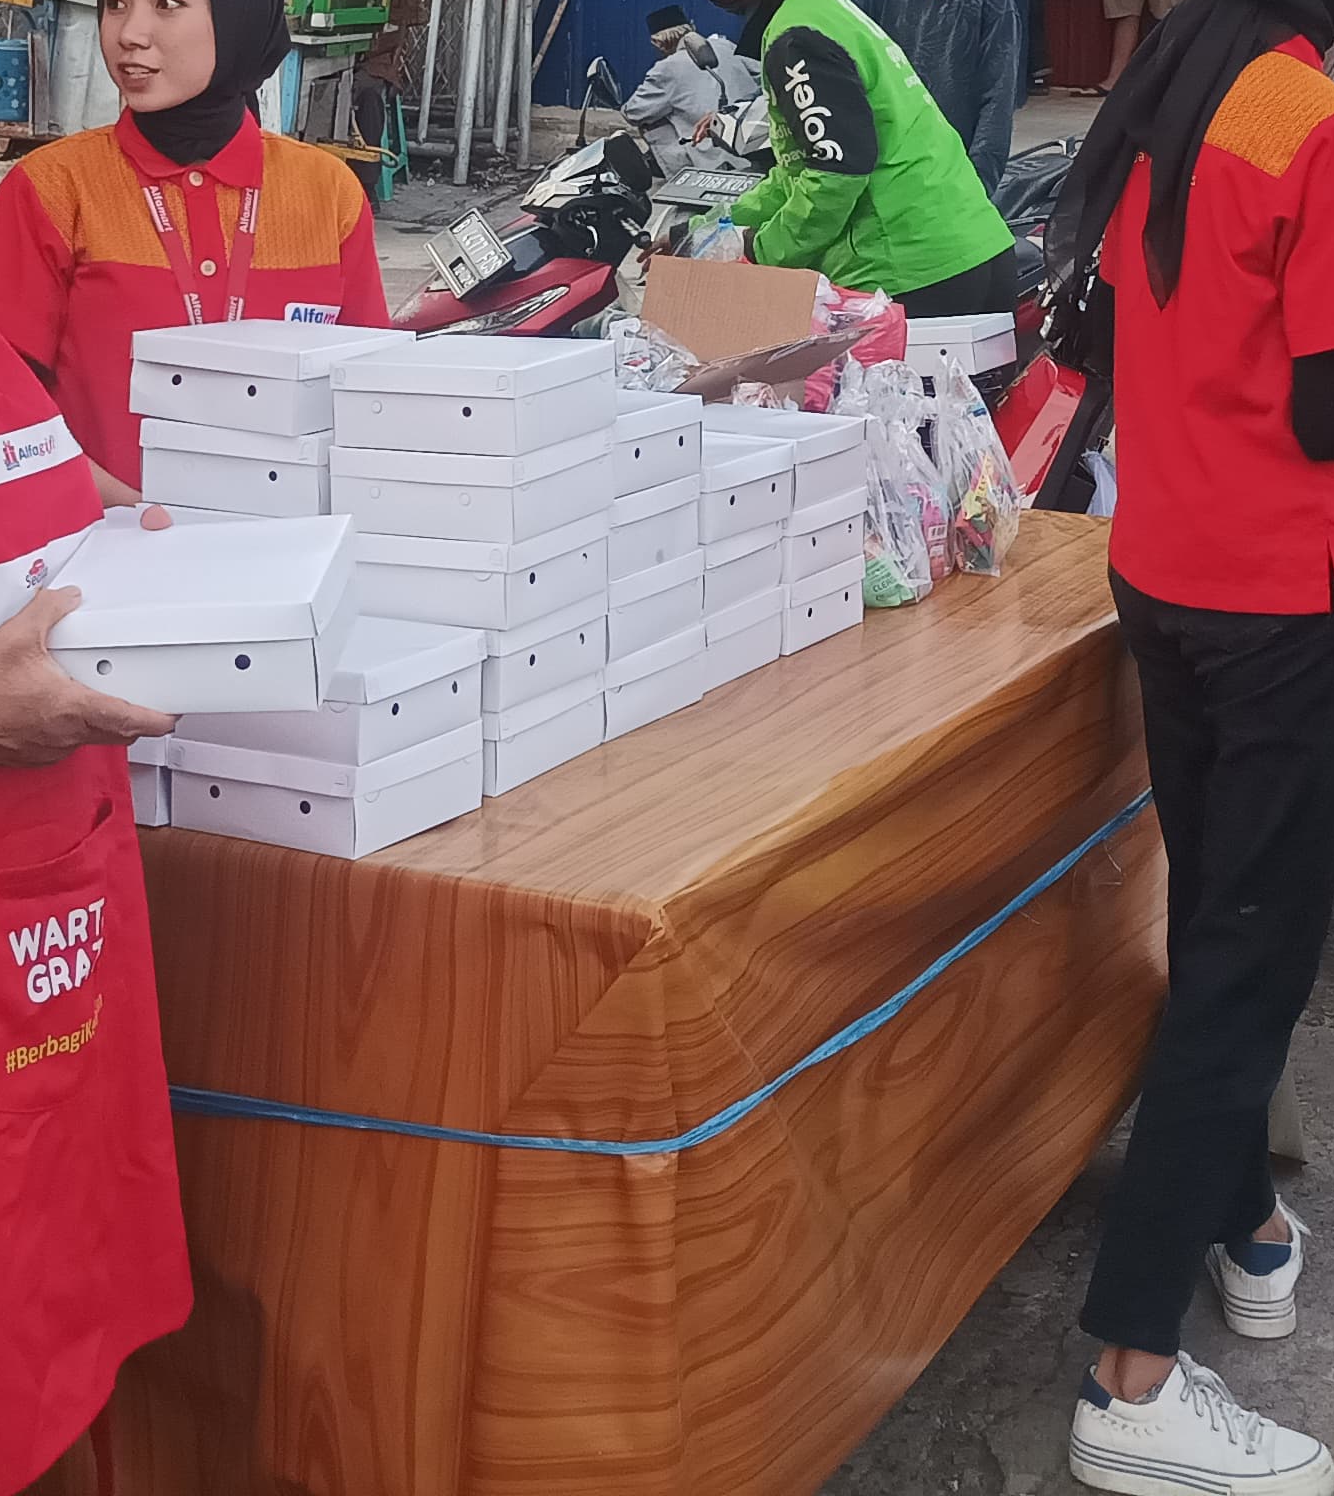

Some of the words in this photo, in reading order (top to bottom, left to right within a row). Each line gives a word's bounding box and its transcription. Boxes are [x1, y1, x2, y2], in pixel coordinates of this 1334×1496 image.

[784, 59, 844, 163] gojek
[149, 185, 174, 232] Alfamart
[239, 187, 254, 233] Alfamart
